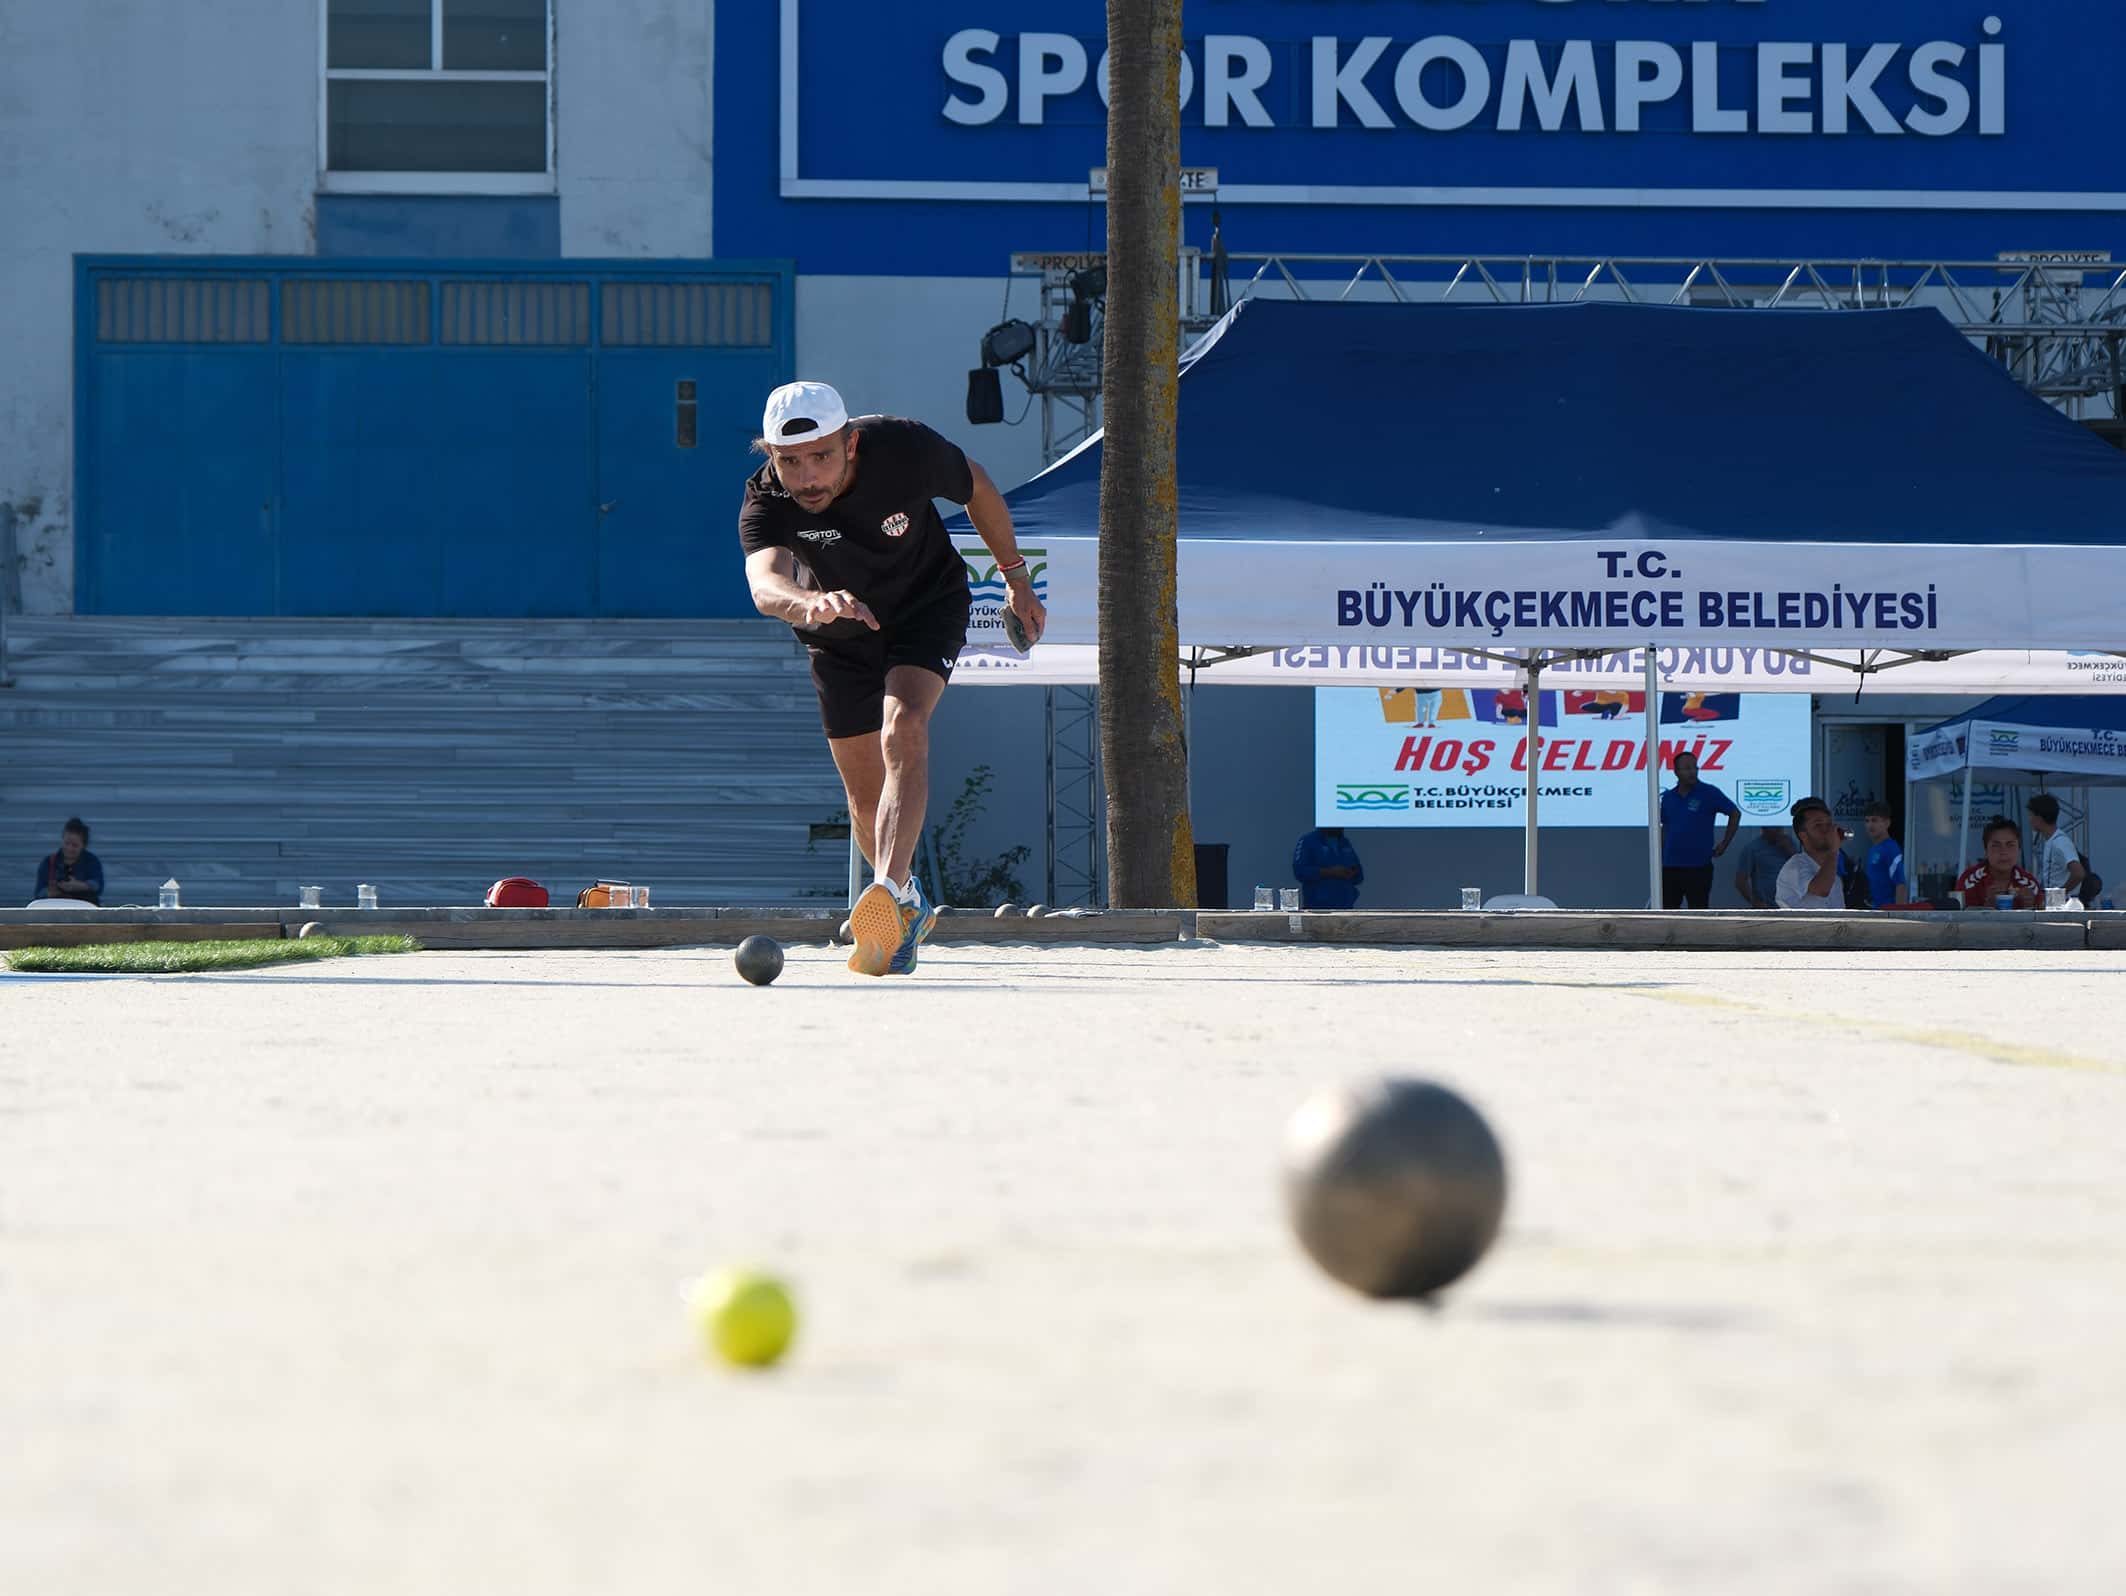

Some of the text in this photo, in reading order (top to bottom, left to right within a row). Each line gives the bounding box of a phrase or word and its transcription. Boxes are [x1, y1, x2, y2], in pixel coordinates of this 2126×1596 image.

[941, 15, 2006, 137] SPR KOMPLEKSİ
[1597, 550, 1682, 578] T.C.
[1337, 582, 1937, 638] BÜYÜKÇEKMECE BELEDİYESİ
[2039, 736, 2115, 757] BÜYÜKÇEKMECE
[2091, 729, 2119, 742] T.C.
[1394, 736, 1497, 776] HOŞ
[1414, 787, 1442, 796] T.C.
[1414, 797, 1512, 809] BELEDİYESİ
